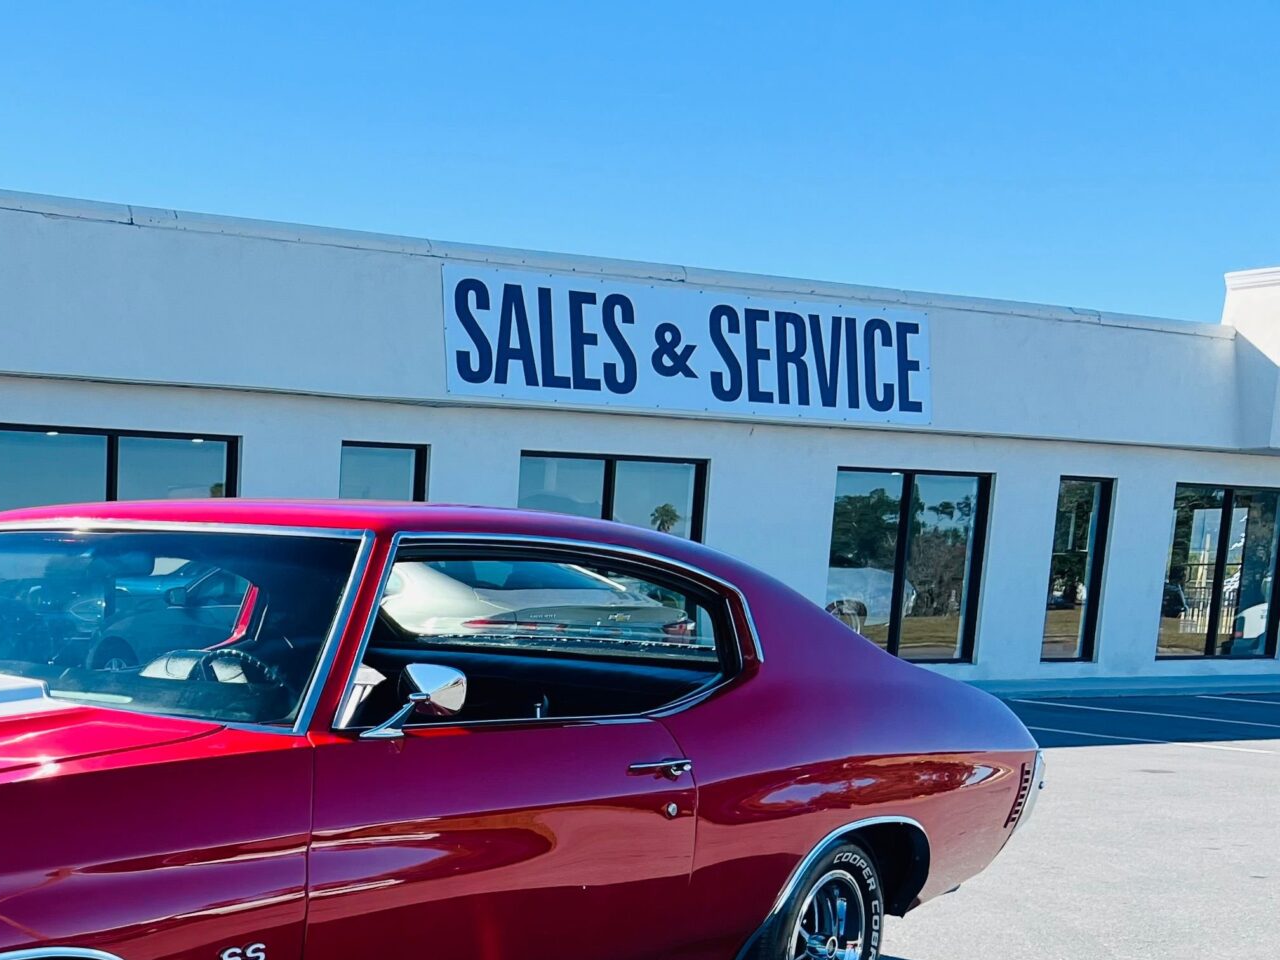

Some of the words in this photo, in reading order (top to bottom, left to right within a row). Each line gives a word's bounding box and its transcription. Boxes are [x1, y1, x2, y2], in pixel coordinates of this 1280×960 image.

[454, 278, 638, 395] SALES
[651, 322, 699, 379] &
[709, 304, 923, 413] SERVICE
[833, 852, 877, 891] COOPER
